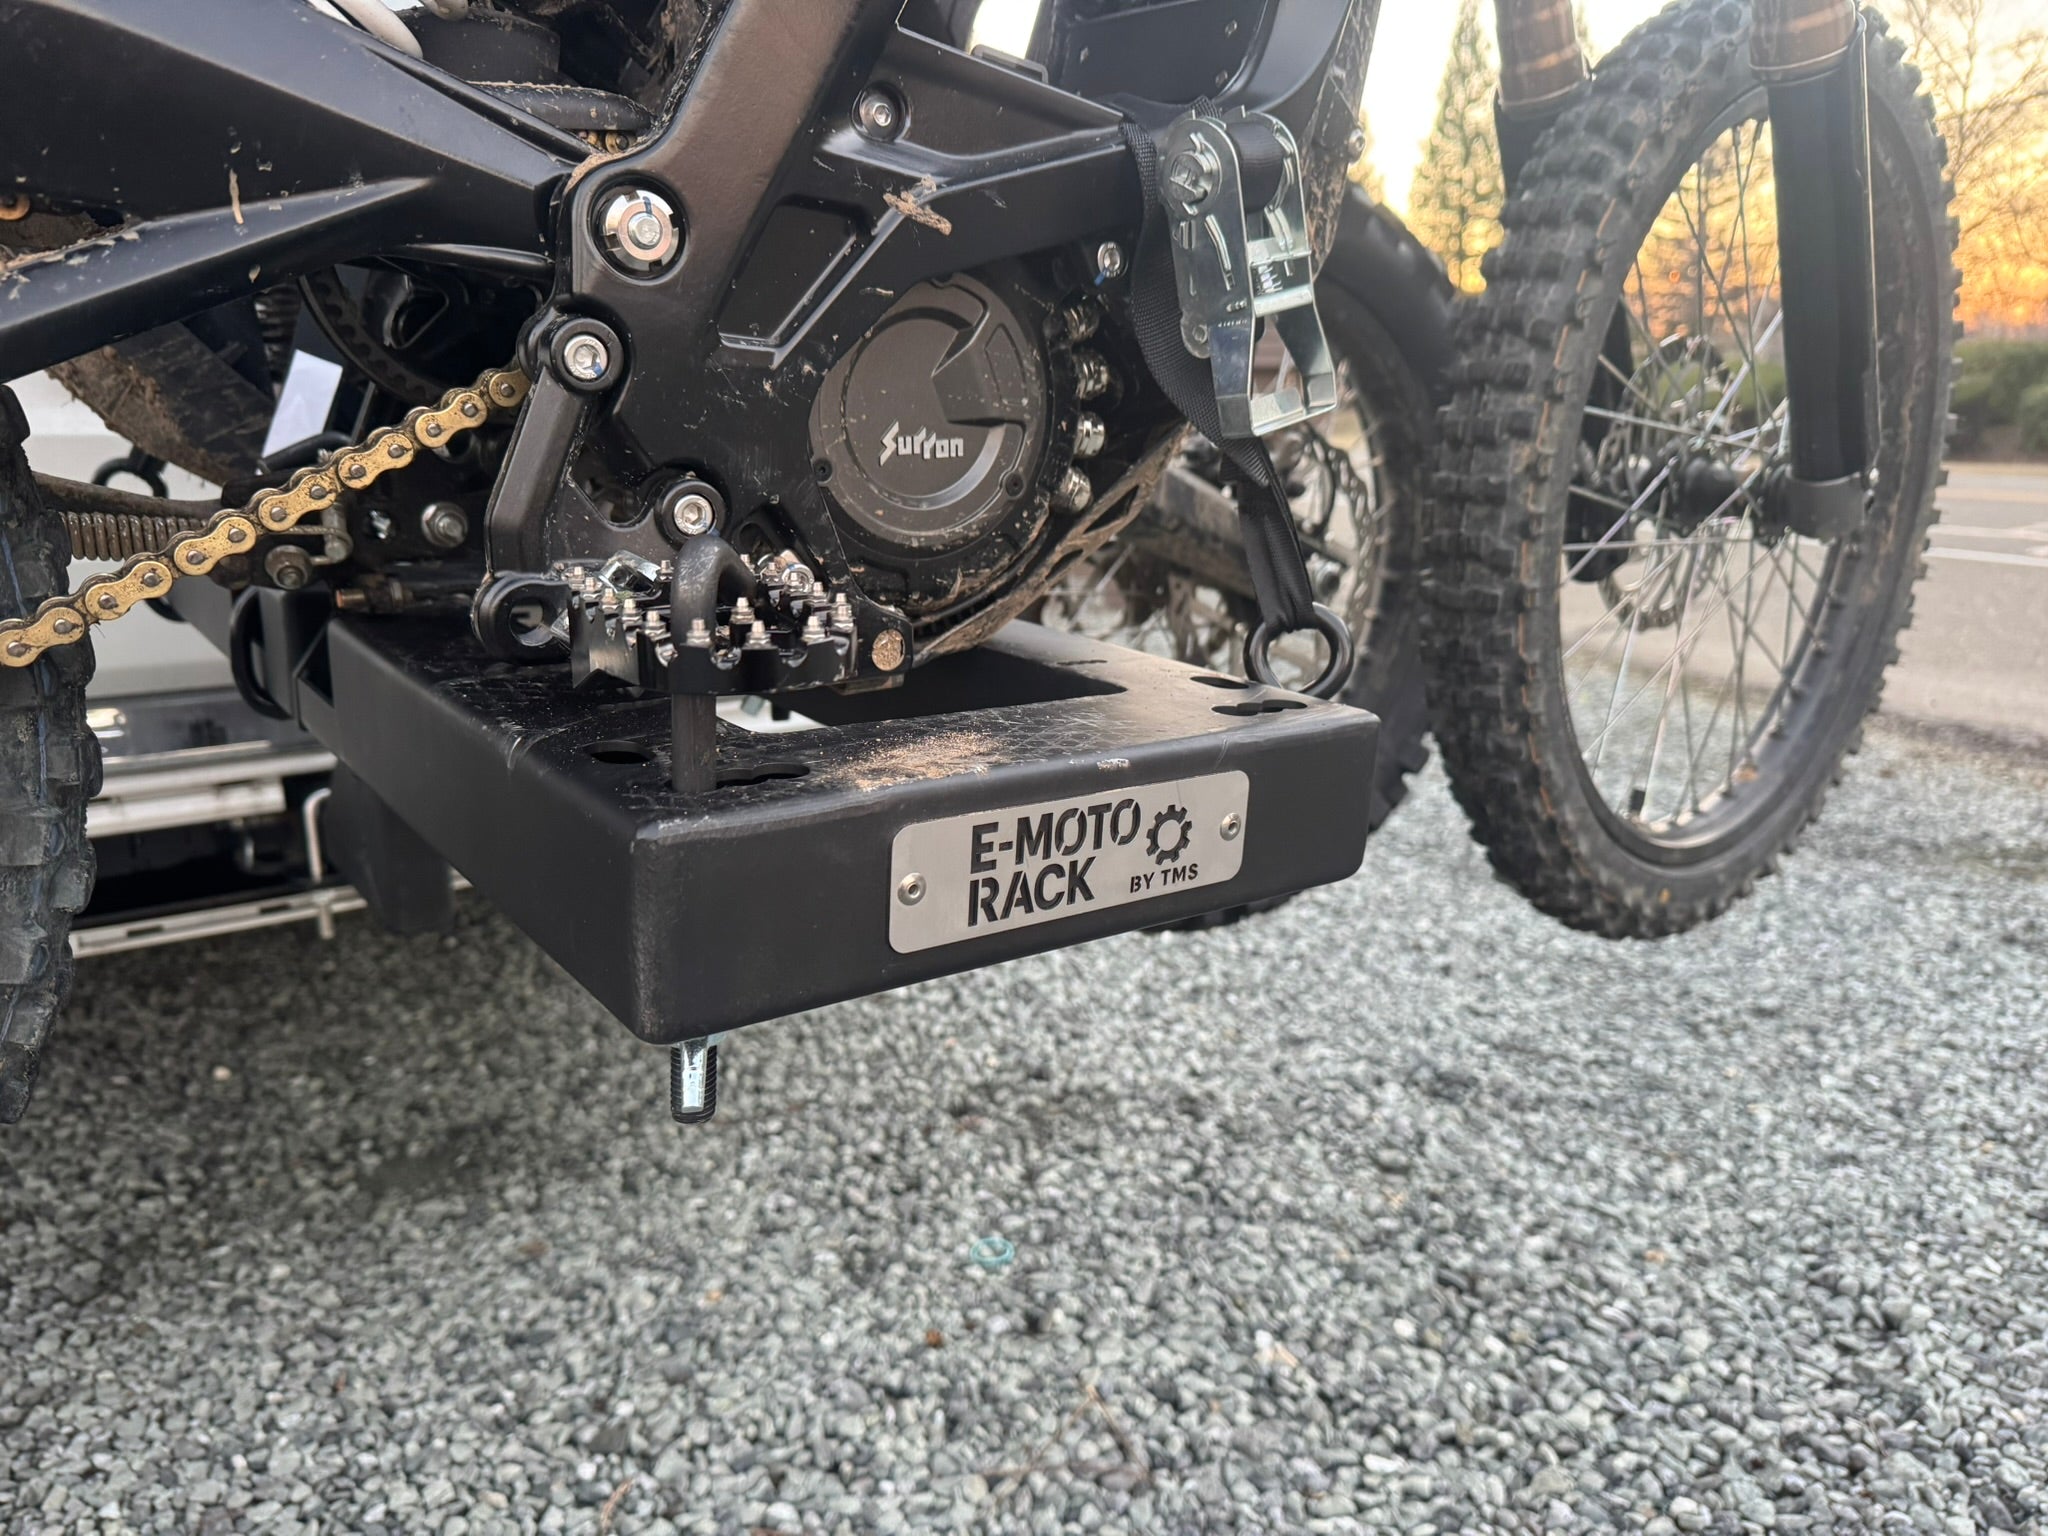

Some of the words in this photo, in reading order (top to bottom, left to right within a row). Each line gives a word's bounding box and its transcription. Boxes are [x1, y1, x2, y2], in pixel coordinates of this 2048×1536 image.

[879, 420, 964, 467] Surron
[970, 798, 1141, 874] E-MOTO
[967, 856, 1096, 927] RACK
[1130, 872, 1155, 893] BY
[1161, 863, 1199, 886] TMS
